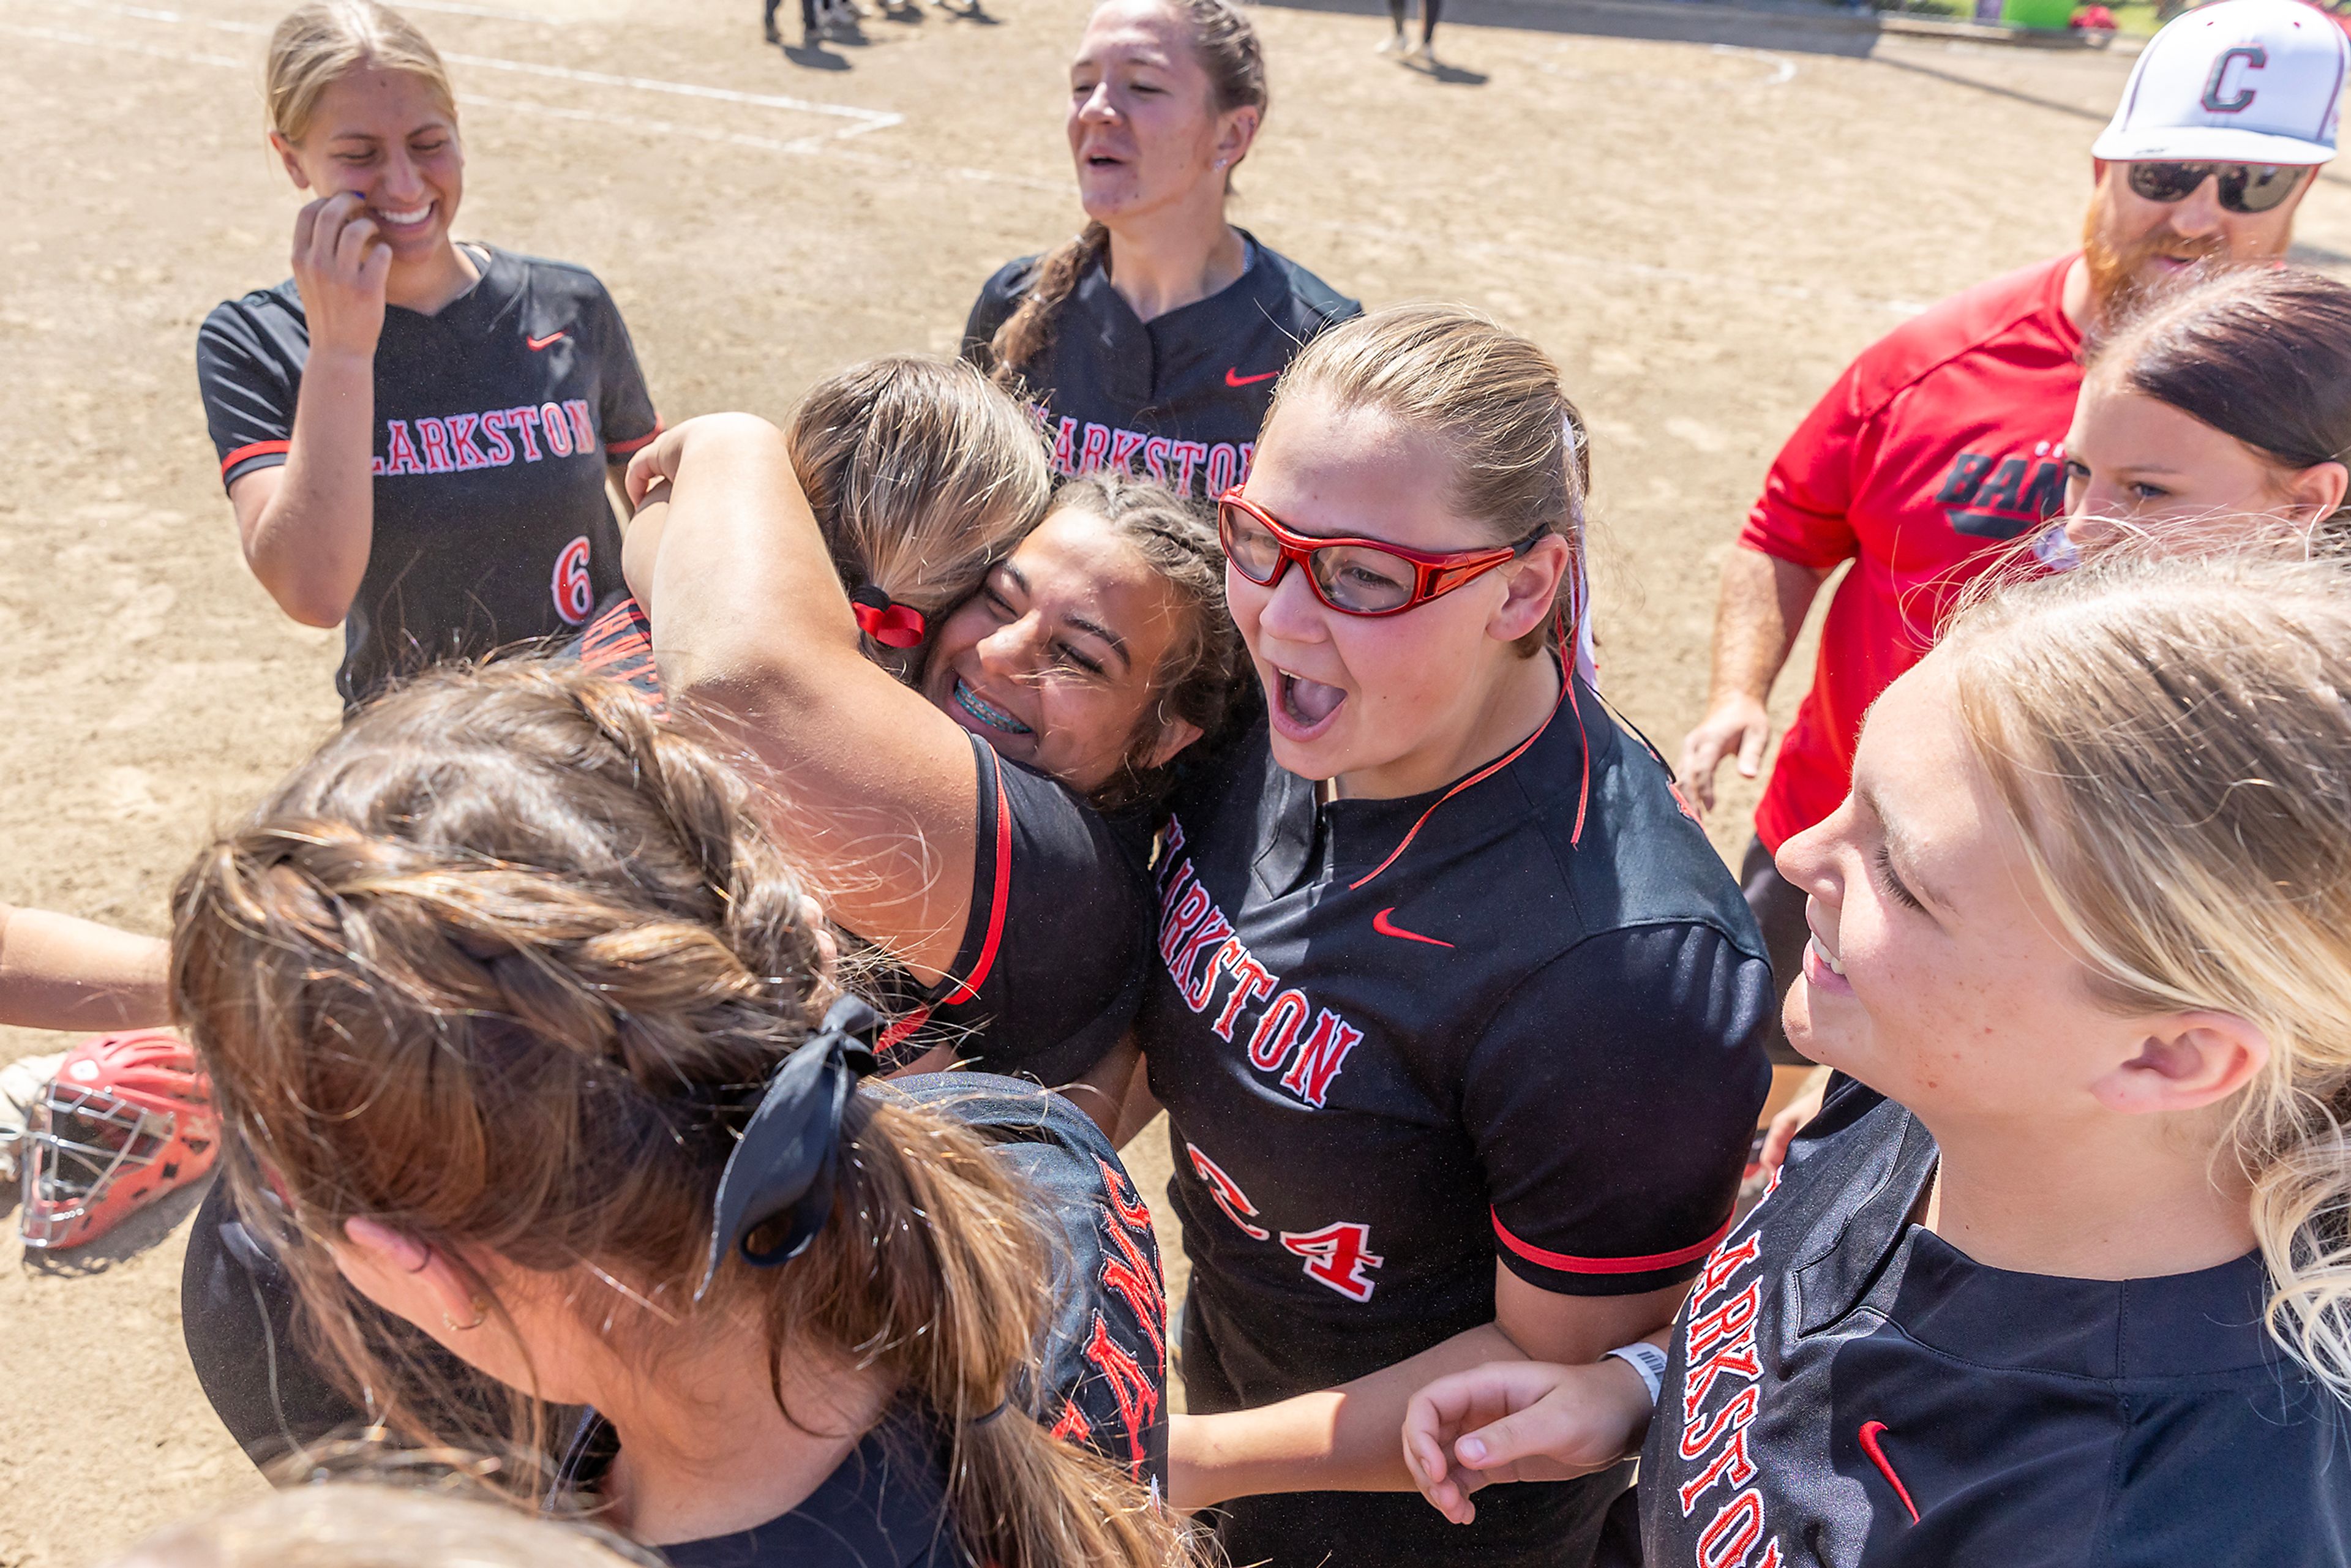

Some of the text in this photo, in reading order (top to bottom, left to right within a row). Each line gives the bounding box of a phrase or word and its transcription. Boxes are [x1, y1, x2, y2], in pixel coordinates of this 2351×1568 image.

[2201, 43, 2268, 112] C
[373, 399, 596, 476] ARKSTON
[550, 535, 594, 625] 6
